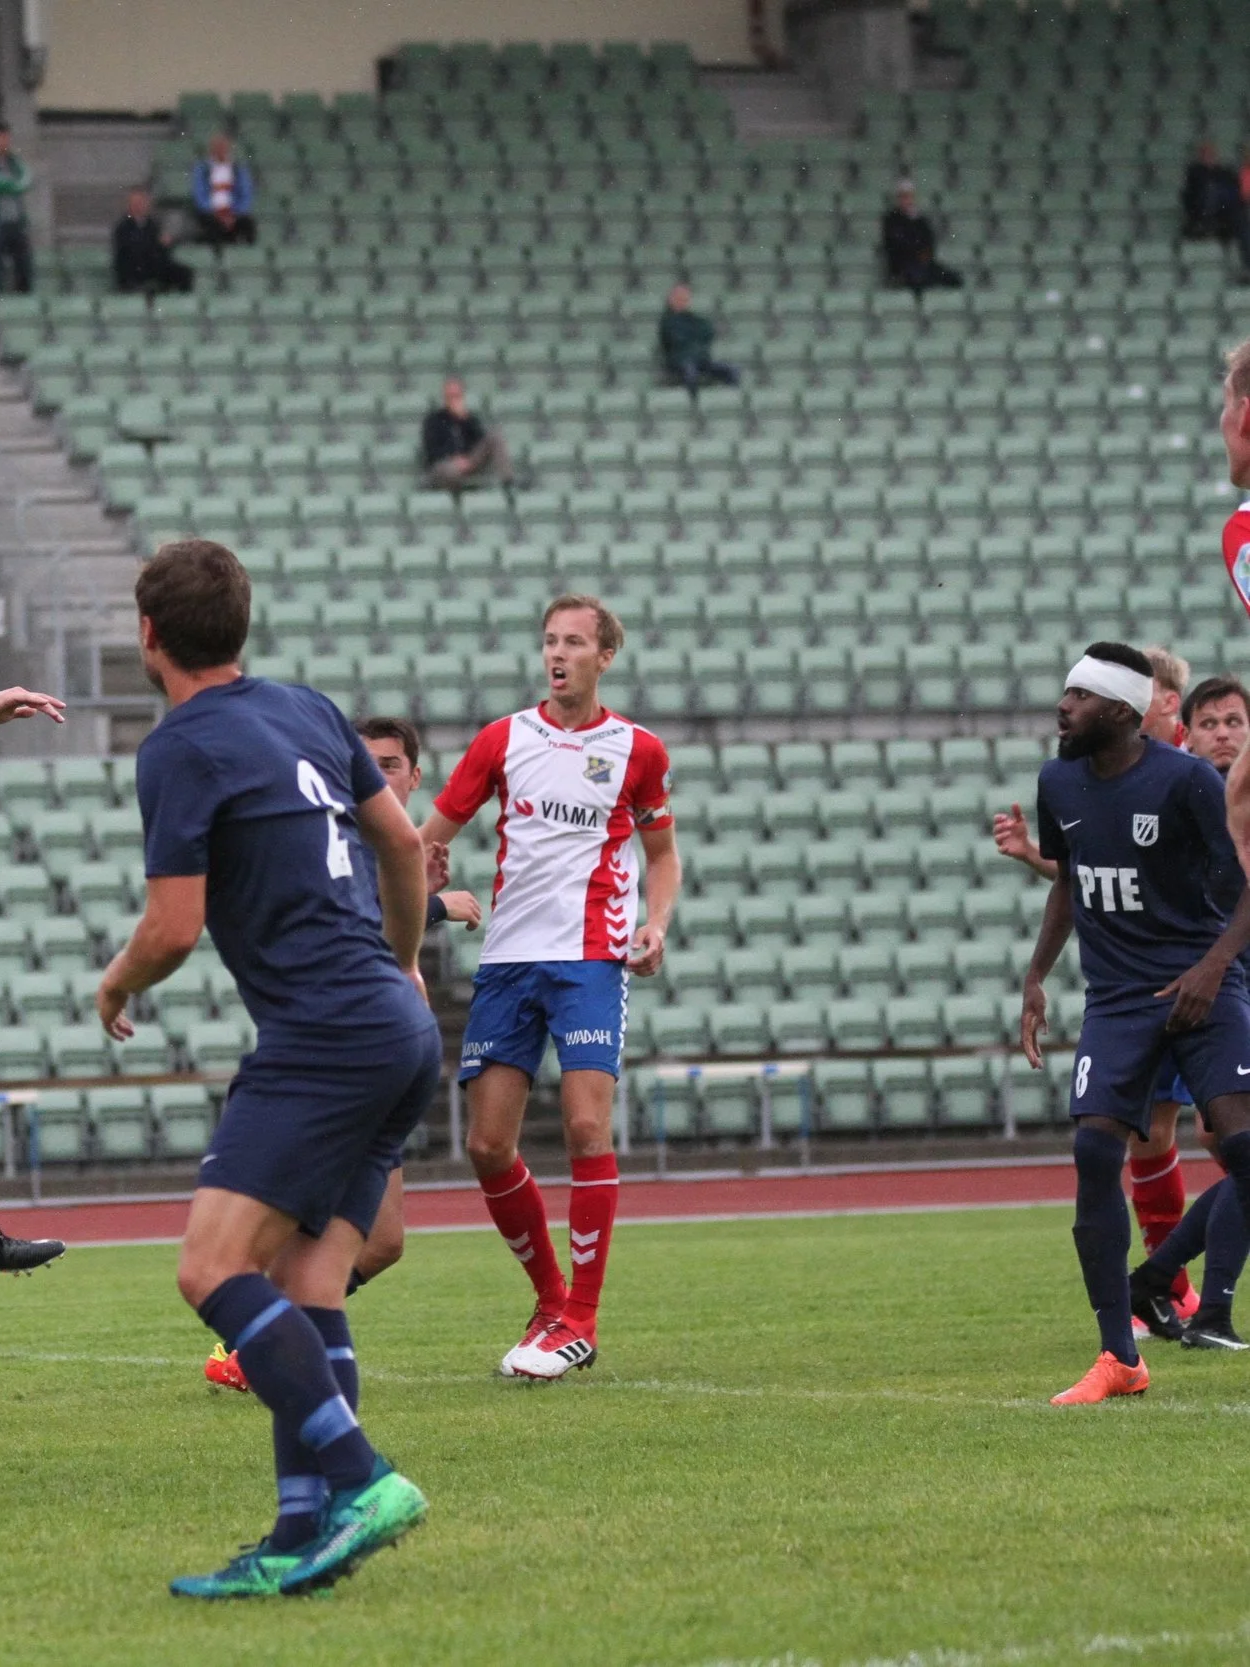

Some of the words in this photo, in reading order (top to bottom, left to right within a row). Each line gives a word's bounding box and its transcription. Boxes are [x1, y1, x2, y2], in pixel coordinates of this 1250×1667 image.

[296, 759, 354, 880] 2
[541, 800, 598, 828] VISMA
[1076, 864, 1144, 912] PTE
[1075, 1055, 1092, 1099] 8
